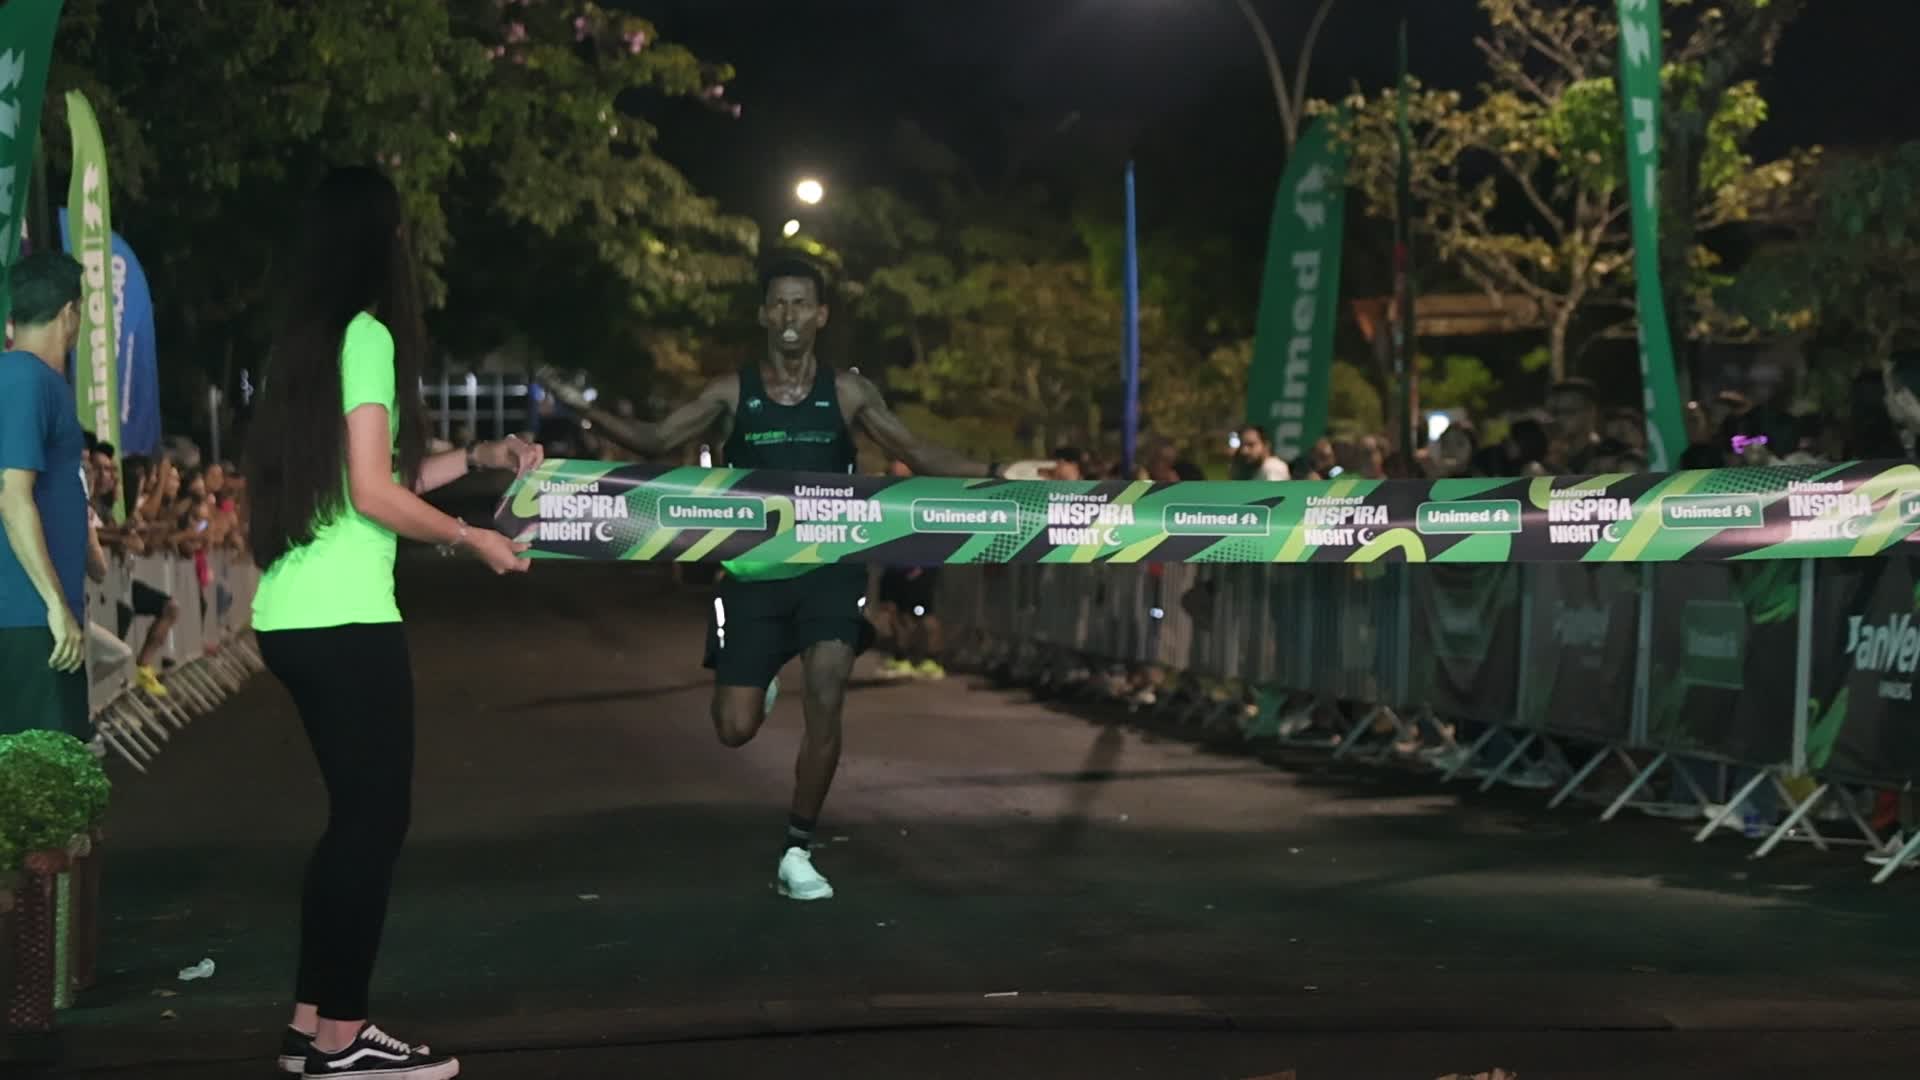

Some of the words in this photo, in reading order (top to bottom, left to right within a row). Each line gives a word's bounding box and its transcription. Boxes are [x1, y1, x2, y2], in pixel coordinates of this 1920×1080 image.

[83, 251, 111, 443] nimed
[1270, 249, 1321, 460] nimed
[539, 480, 599, 494] Unimed
[794, 484, 854, 498] Unimed
[1550, 486, 1606, 499] Unimed
[1788, 480, 1844, 493] Unimed
[1048, 492, 1108, 503] Unimed
[1305, 495, 1364, 506] Unimed
[669, 504, 734, 519] Unimed
[923, 508, 988, 524] Unimed
[1175, 511, 1237, 526] Unimed
[1427, 509, 1490, 523] Unimed
[1670, 505, 1732, 519] Unimed
[796, 524, 848, 543] NIGHT
[1048, 527, 1100, 546] NIGHT
[1304, 528, 1355, 547] NIGHT
